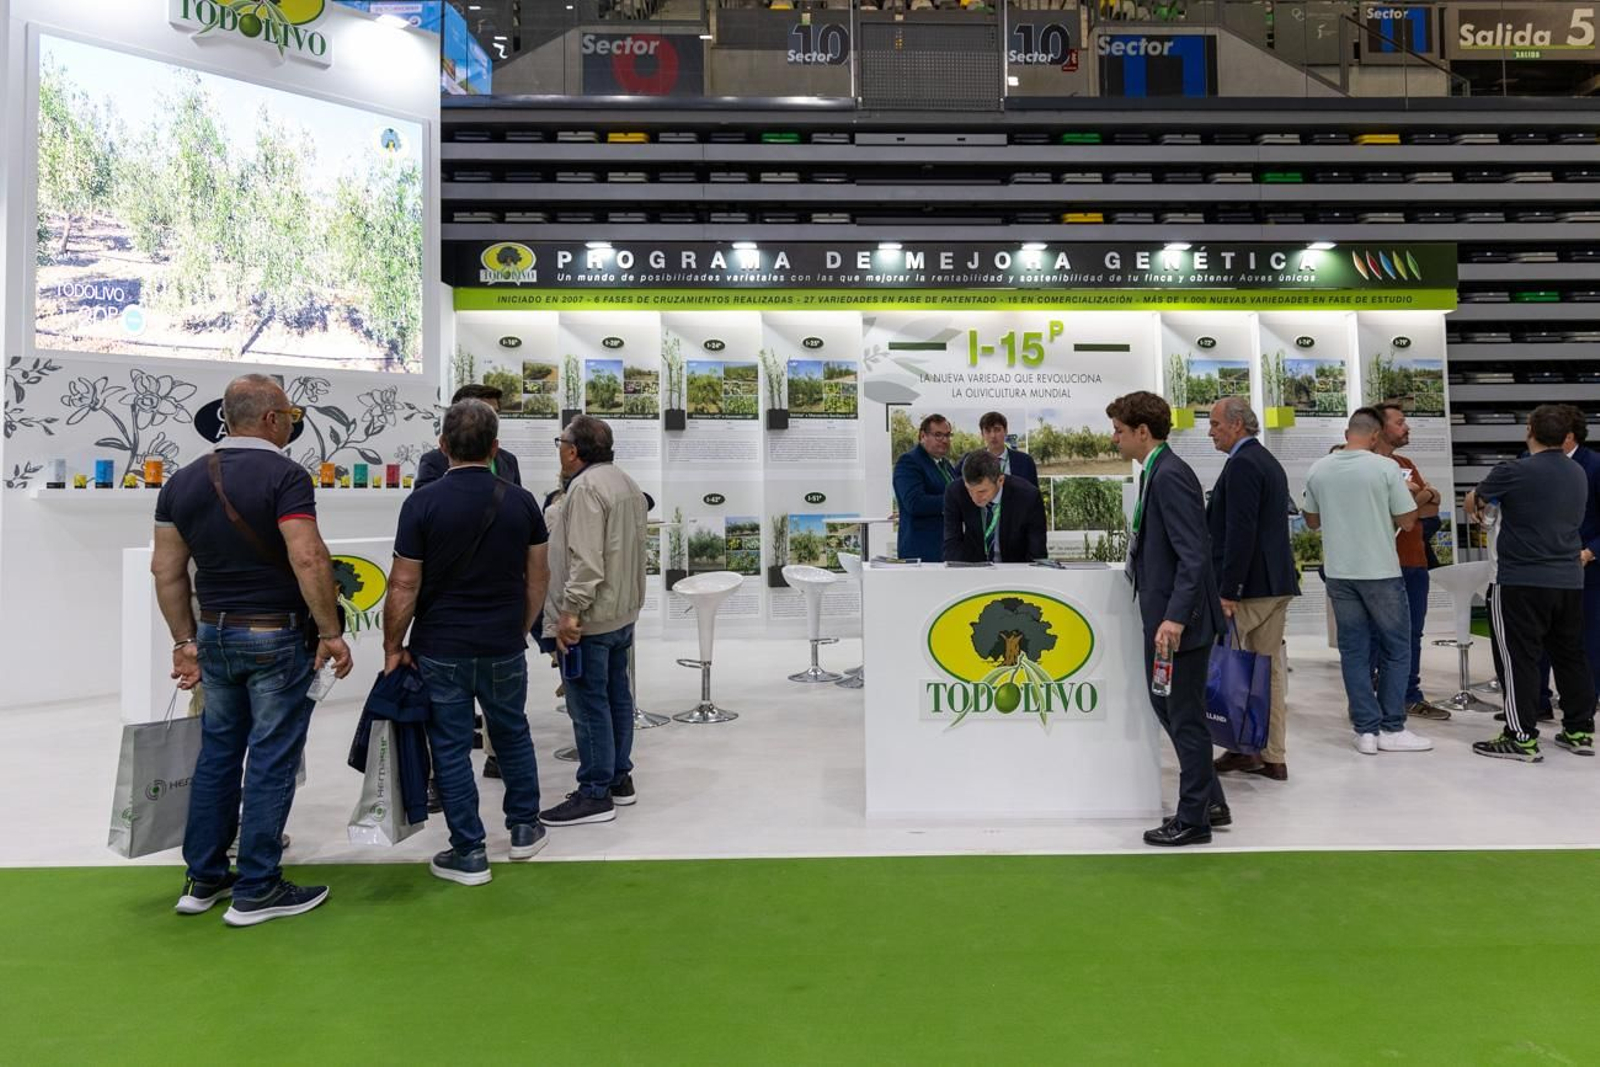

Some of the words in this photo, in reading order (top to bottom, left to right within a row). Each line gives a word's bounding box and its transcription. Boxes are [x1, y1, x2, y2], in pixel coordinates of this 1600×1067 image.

[1366, 8, 1409, 20] Sector
[1459, 23, 1552, 46] Salida
[1566, 8, 1595, 46] 5
[582, 34, 659, 55] Sector
[791, 22, 849, 66] 10
[1013, 23, 1071, 66] 10
[1098, 35, 1174, 56] Sector
[787, 50, 832, 63] Sector
[1008, 50, 1054, 62] Sector
[556, 250, 791, 271] PROGRAMA
[826, 252, 872, 271] DE
[557, 273, 572, 282] Un
[577, 273, 616, 282] mundo
[620, 273, 635, 282] de
[639, 273, 721, 285] posibilidades
[726, 273, 786, 282] varietales
[790, 275, 812, 283] con
[816, 274, 835, 283] las
[839, 275, 861, 285] que
[865, 274, 911, 285] mejorar
[914, 274, 926, 283] la
[931, 274, 1004, 284] rentabilidad
[1007, 276, 1015, 286] y
[1019, 274, 1104, 284] sostenibilidad
[1108, 274, 1122, 283] de
[1127, 274, 1140, 283] tu
[1143, 274, 1173, 284] finca
[1178, 276, 1185, 286] y
[1189, 274, 1235, 284] obtener
[1278, 273, 1316, 284] únicos
[497, 295, 542, 304] INICIADO
[545, 295, 559, 304] EN
[561, 295, 584, 304] 2007
[593, 295, 600, 304] 6
[602, 295, 633, 304] FASES
[637, 295, 650, 304] DE
[652, 295, 730, 304] CRUZAMIENTOS
[733, 295, 793, 304] REALIZADAS
[803, 295, 814, 304] 27
[817, 295, 879, 304] VARIEDADES
[881, 295, 896, 304] EN
[897, 295, 922, 304] FASE
[924, 295, 938, 304] DE
[940, 295, 997, 304] PATENTADO
[1020, 295, 1034, 304] EN
[1037, 294, 1133, 304] COMERCIALIZACIÓN
[1142, 294, 1166, 304] MÁS
[1166, 295, 1180, 304] DE
[1183, 295, 1207, 304] 1.000
[1209, 295, 1247, 304] NUEVAS
[1249, 295, 1310, 304] VARIEDADES
[1312, 295, 1326, 304] EN
[1328, 295, 1352, 304] FASE
[1355, 295, 1368, 304] DE
[1371, 295, 1413, 304] ESTUDIO
[919, 374, 931, 384] LA
[933, 374, 965, 384] NUEVA
[967, 374, 1011, 384] VARIEDAD
[1016, 374, 1034, 385] QUE
[1036, 374, 1102, 384] REVOLUCIONA
[951, 389, 962, 399] LA
[965, 389, 1027, 399] OLIVICULTURA
[1030, 389, 1071, 399] MUNDIAL
[931, 681, 1103, 714] TODOLIVO
